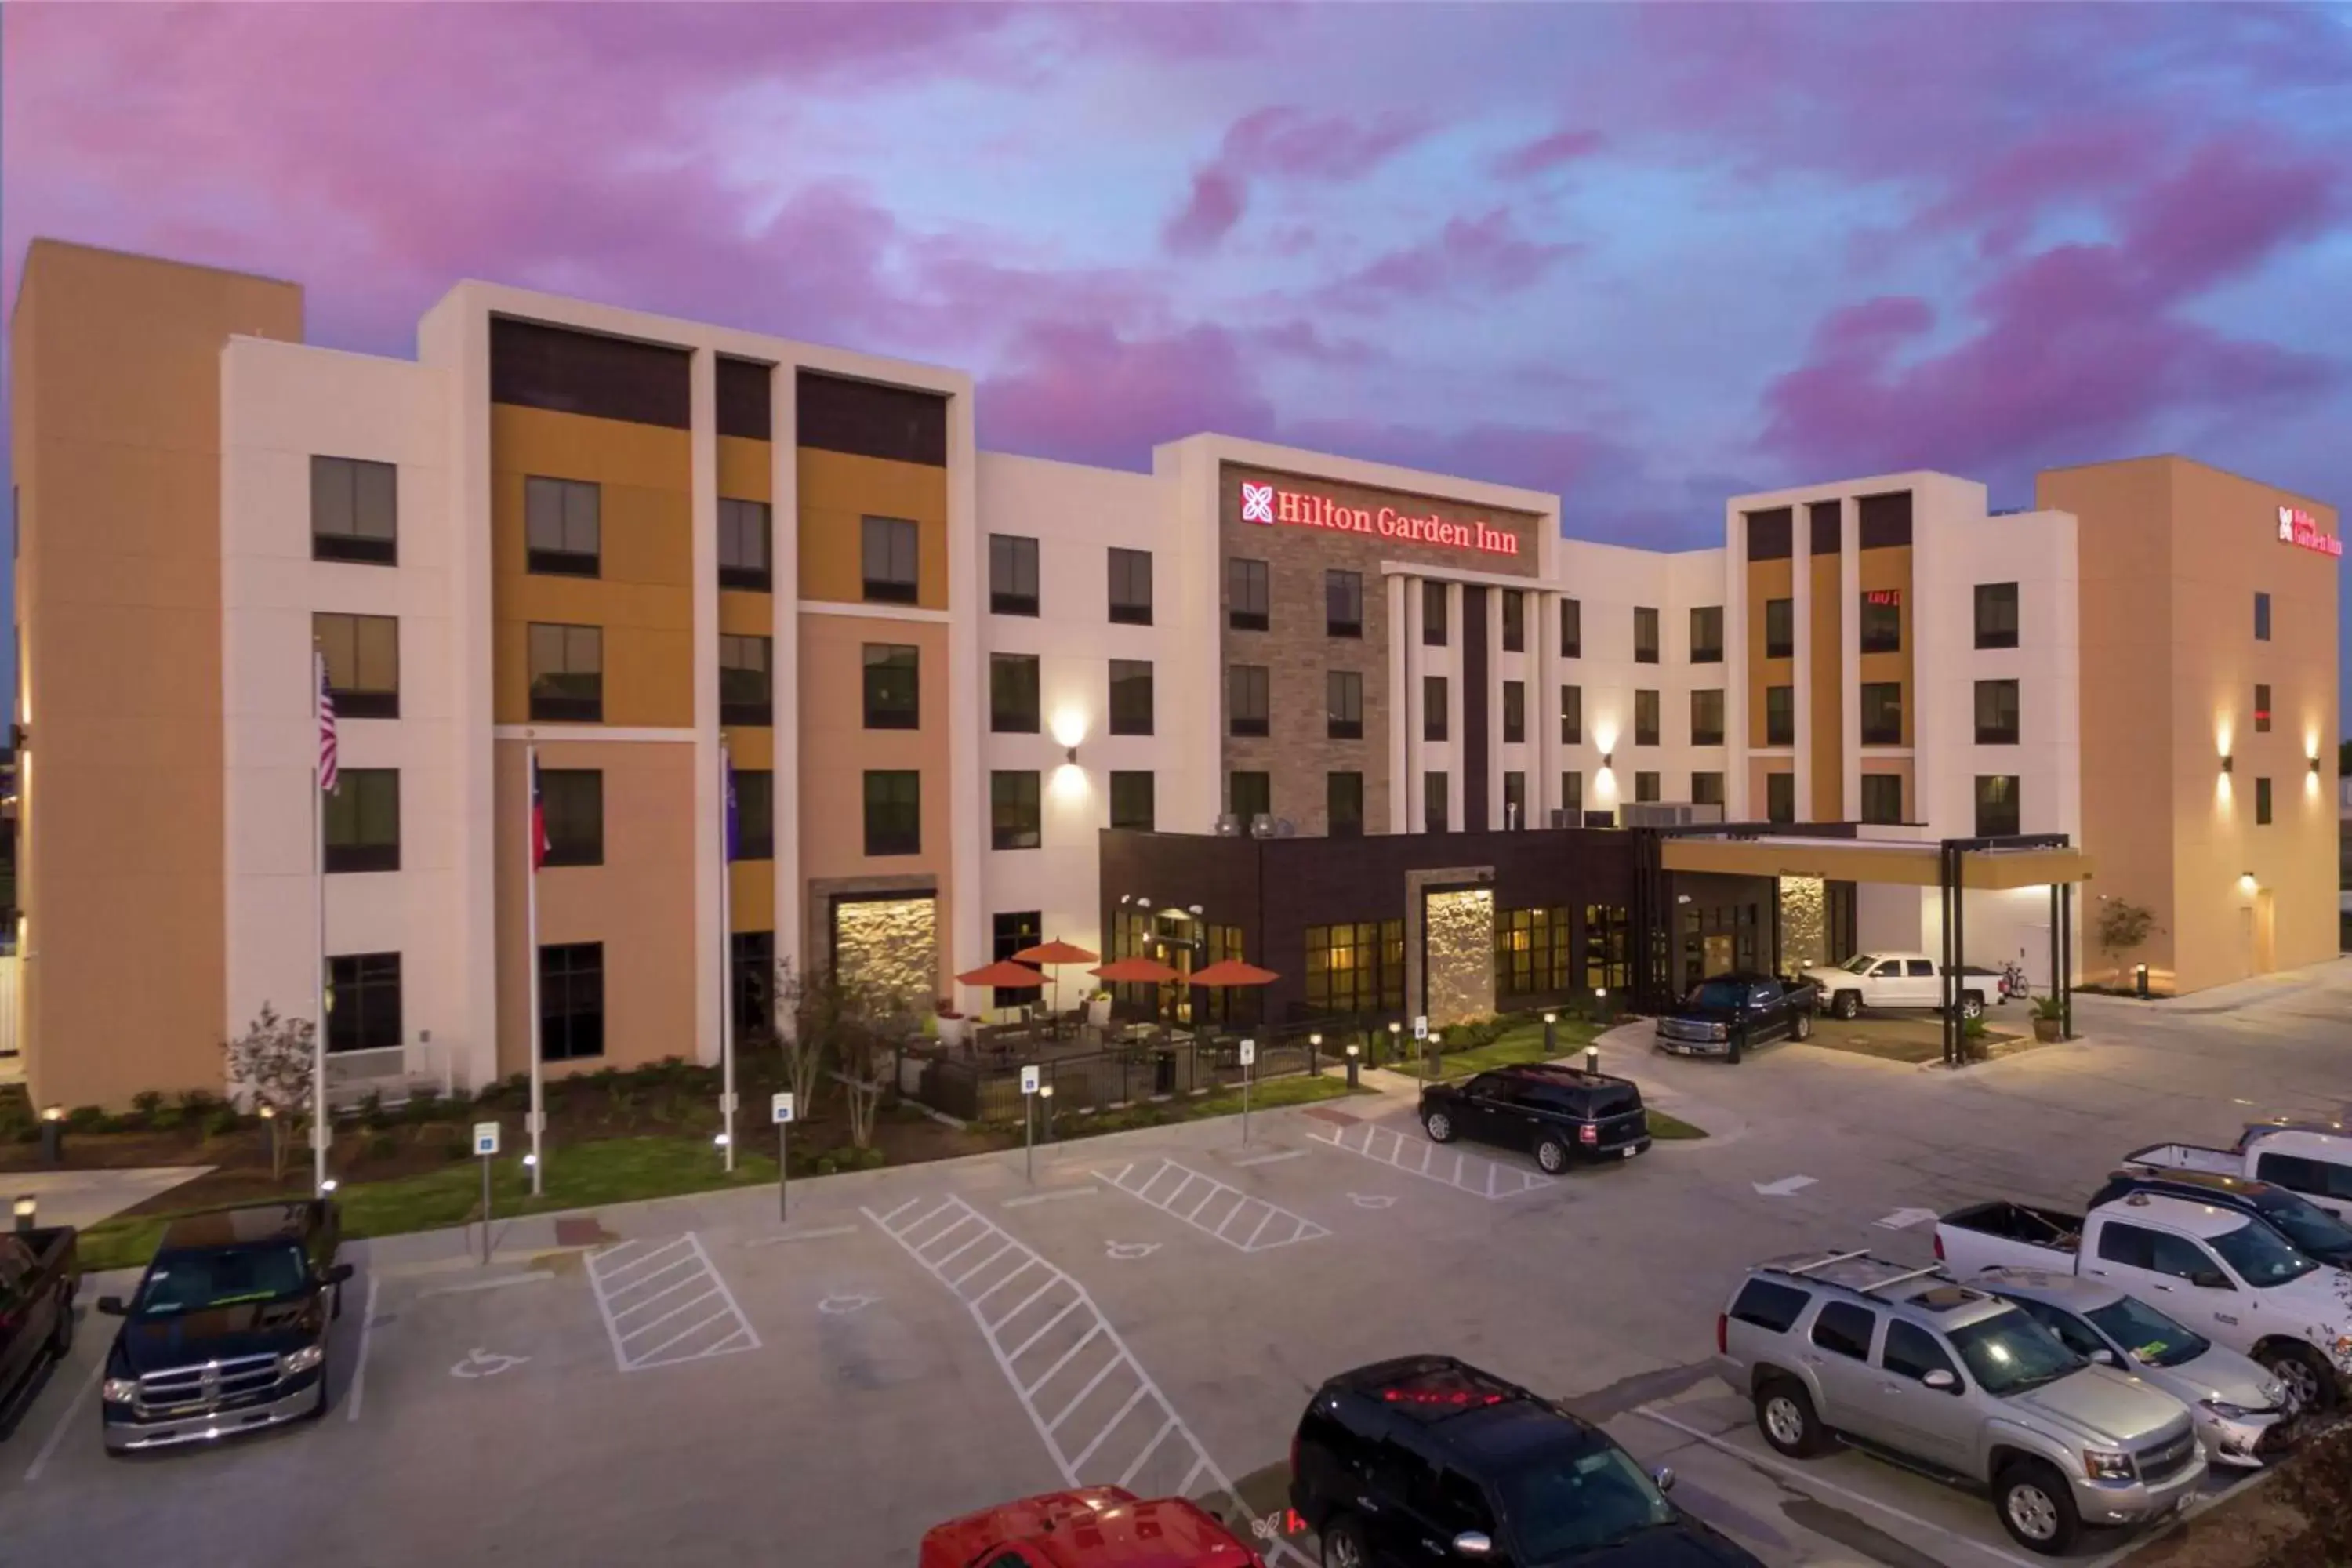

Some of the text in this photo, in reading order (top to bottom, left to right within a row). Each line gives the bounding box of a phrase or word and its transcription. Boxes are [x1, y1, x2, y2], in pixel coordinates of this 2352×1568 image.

[1277, 491, 1518, 554] Hilton Garden Inn
